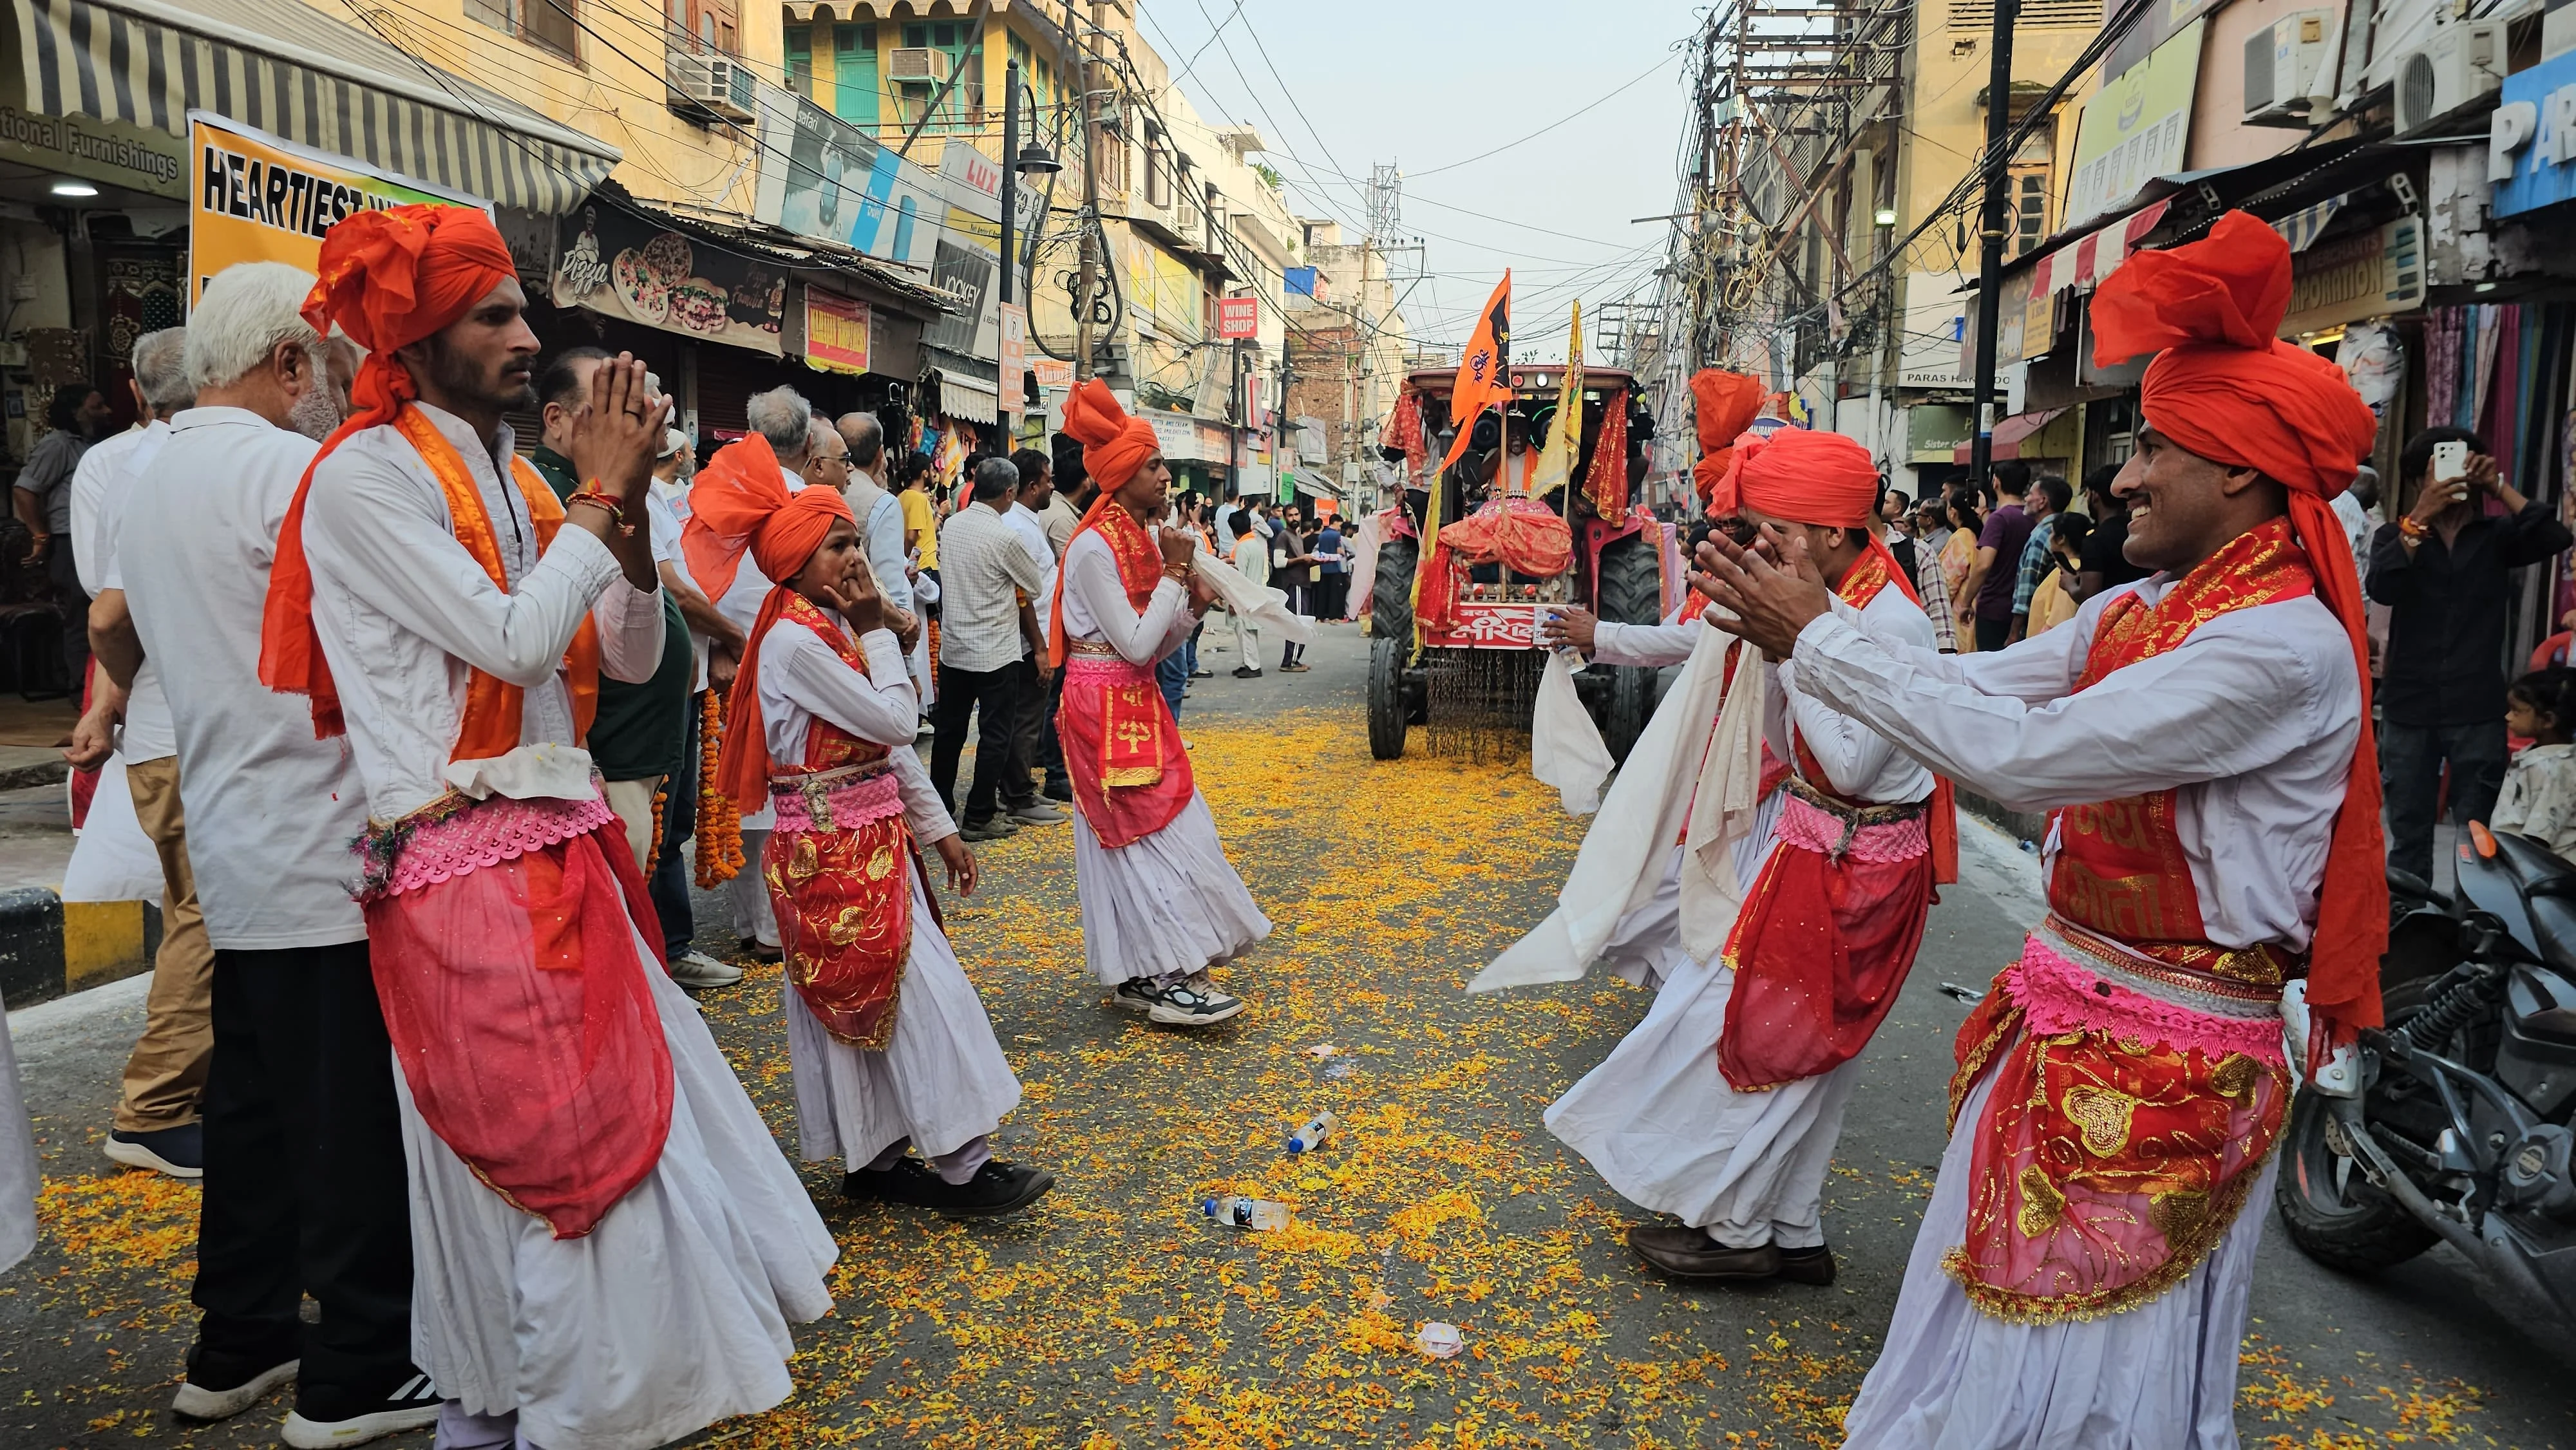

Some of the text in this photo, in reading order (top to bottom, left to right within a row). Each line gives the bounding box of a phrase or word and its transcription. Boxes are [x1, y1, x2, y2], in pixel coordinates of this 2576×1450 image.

[797, 109, 819, 131] safari
[65, 122, 178, 184] Furnishings
[967, 158, 998, 194] LUX
[561, 250, 608, 294] Pizza
[940, 275, 981, 309] JOCKEY
[1224, 304, 1254, 318] WINE
[1224, 319, 1255, 333] SHOP
[1908, 373, 1947, 382] PARAS
[1924, 440, 1949, 449] Sister
